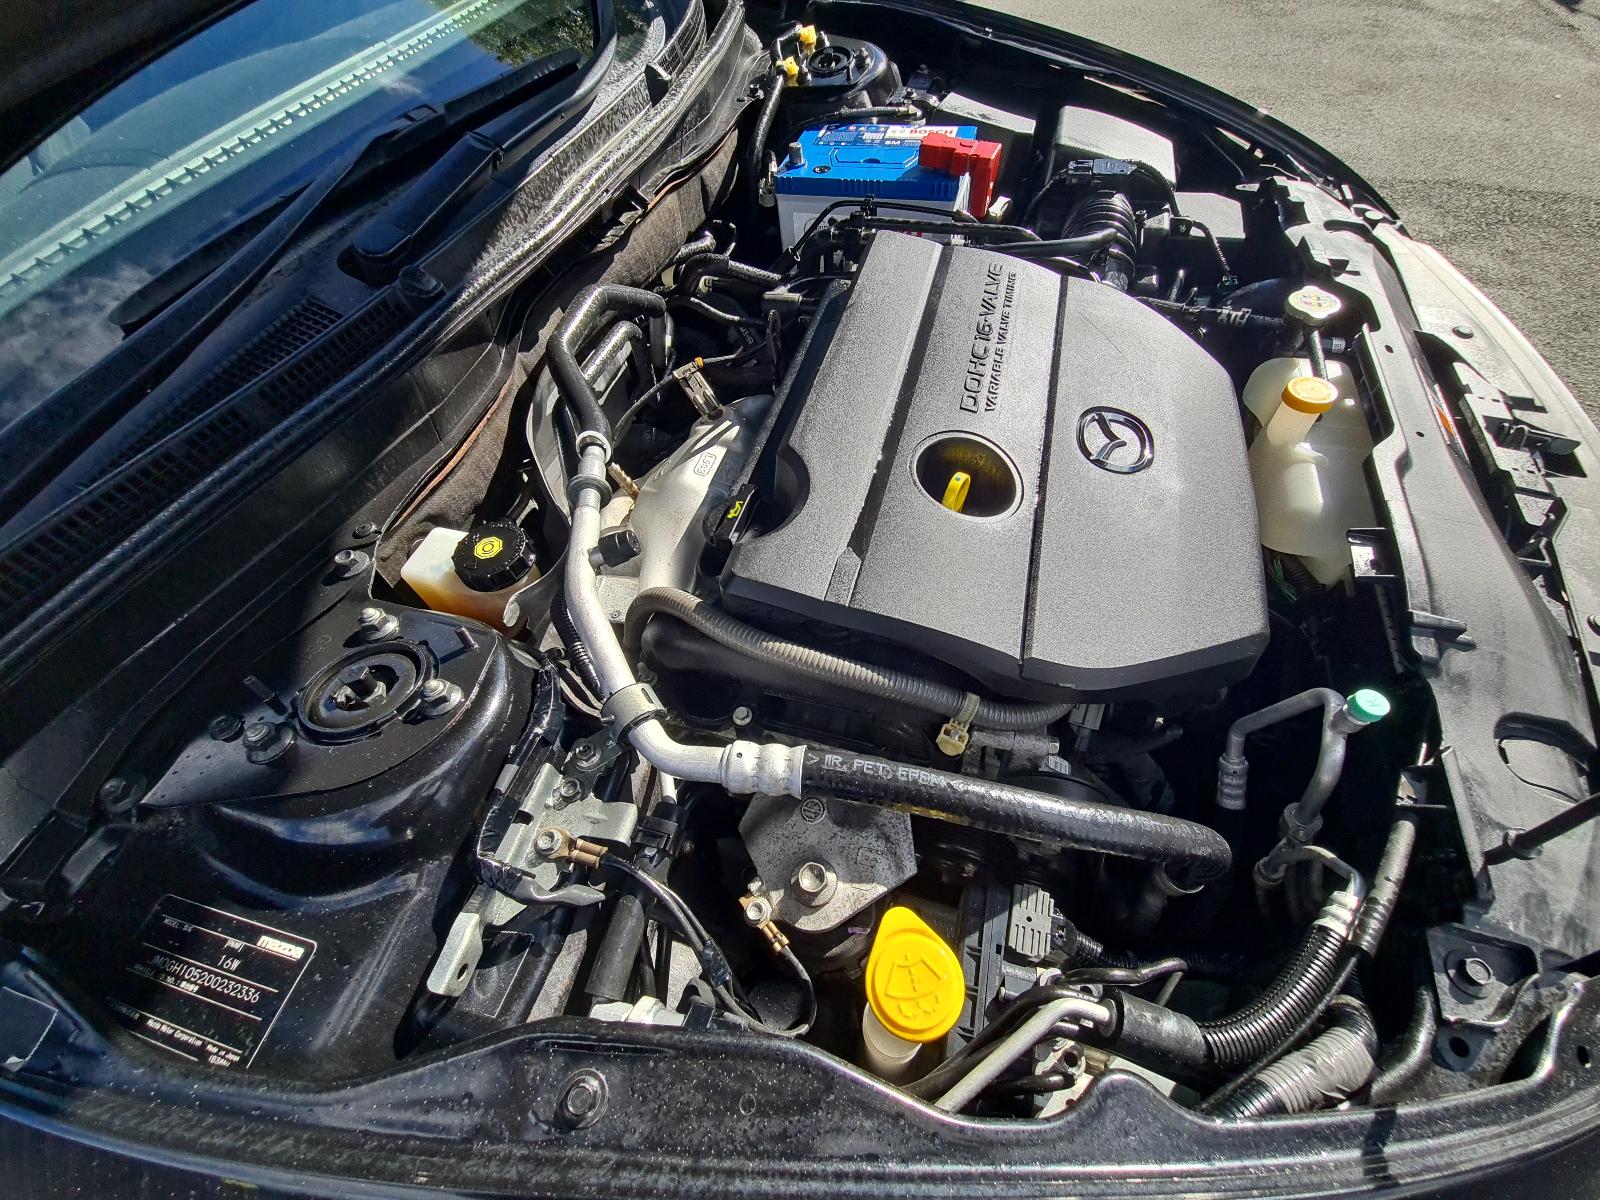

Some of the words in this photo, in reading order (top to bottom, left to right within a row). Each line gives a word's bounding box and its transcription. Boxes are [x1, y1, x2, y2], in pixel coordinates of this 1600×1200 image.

[974, 261, 1004, 343] 16-VALVE
[1003, 272, 1017, 309] TIMING
[996, 310, 1011, 345] VALVE
[959, 343, 991, 414] DOHC
[984, 348, 1005, 413] VARIABLE
[217, 954, 242, 972] 16W
